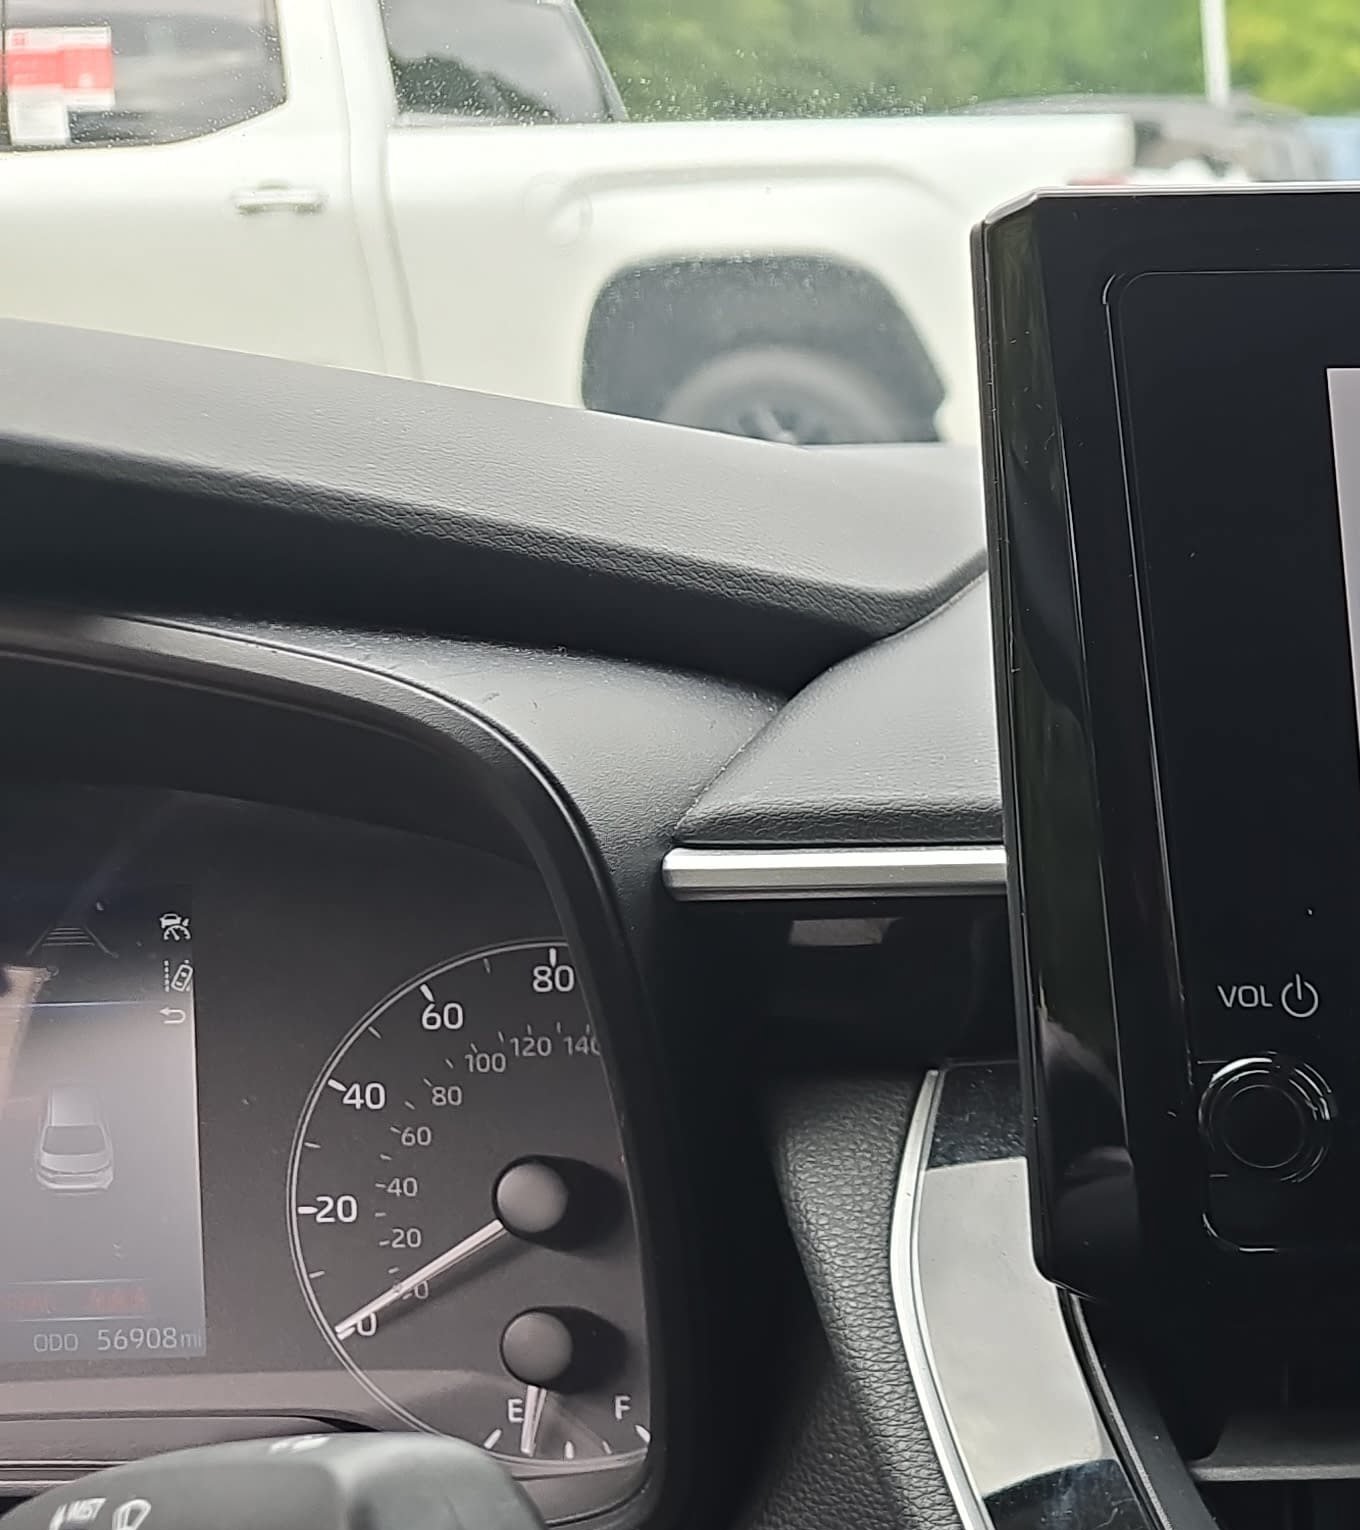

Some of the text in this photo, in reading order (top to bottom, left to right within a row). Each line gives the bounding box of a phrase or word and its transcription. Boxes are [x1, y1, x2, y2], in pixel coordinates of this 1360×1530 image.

[531, 966, 575, 992] 80
[1217, 984, 1273, 1008] VOL
[422, 1003, 464, 1029] 60
[511, 1035, 552, 1057] 120
[465, 1052, 506, 1074] 100
[343, 1083, 386, 1110] 40
[431, 1085, 462, 1107] 80
[401, 1126, 432, 1147] 60
[387, 1177, 418, 1197] 40
[315, 1196, 358, 1223] 20
[391, 1228, 422, 1249] 20
[33, 1333, 78, 1352] ODO
[508, 1399, 523, 1422] E
[614, 1395, 631, 1419] F
